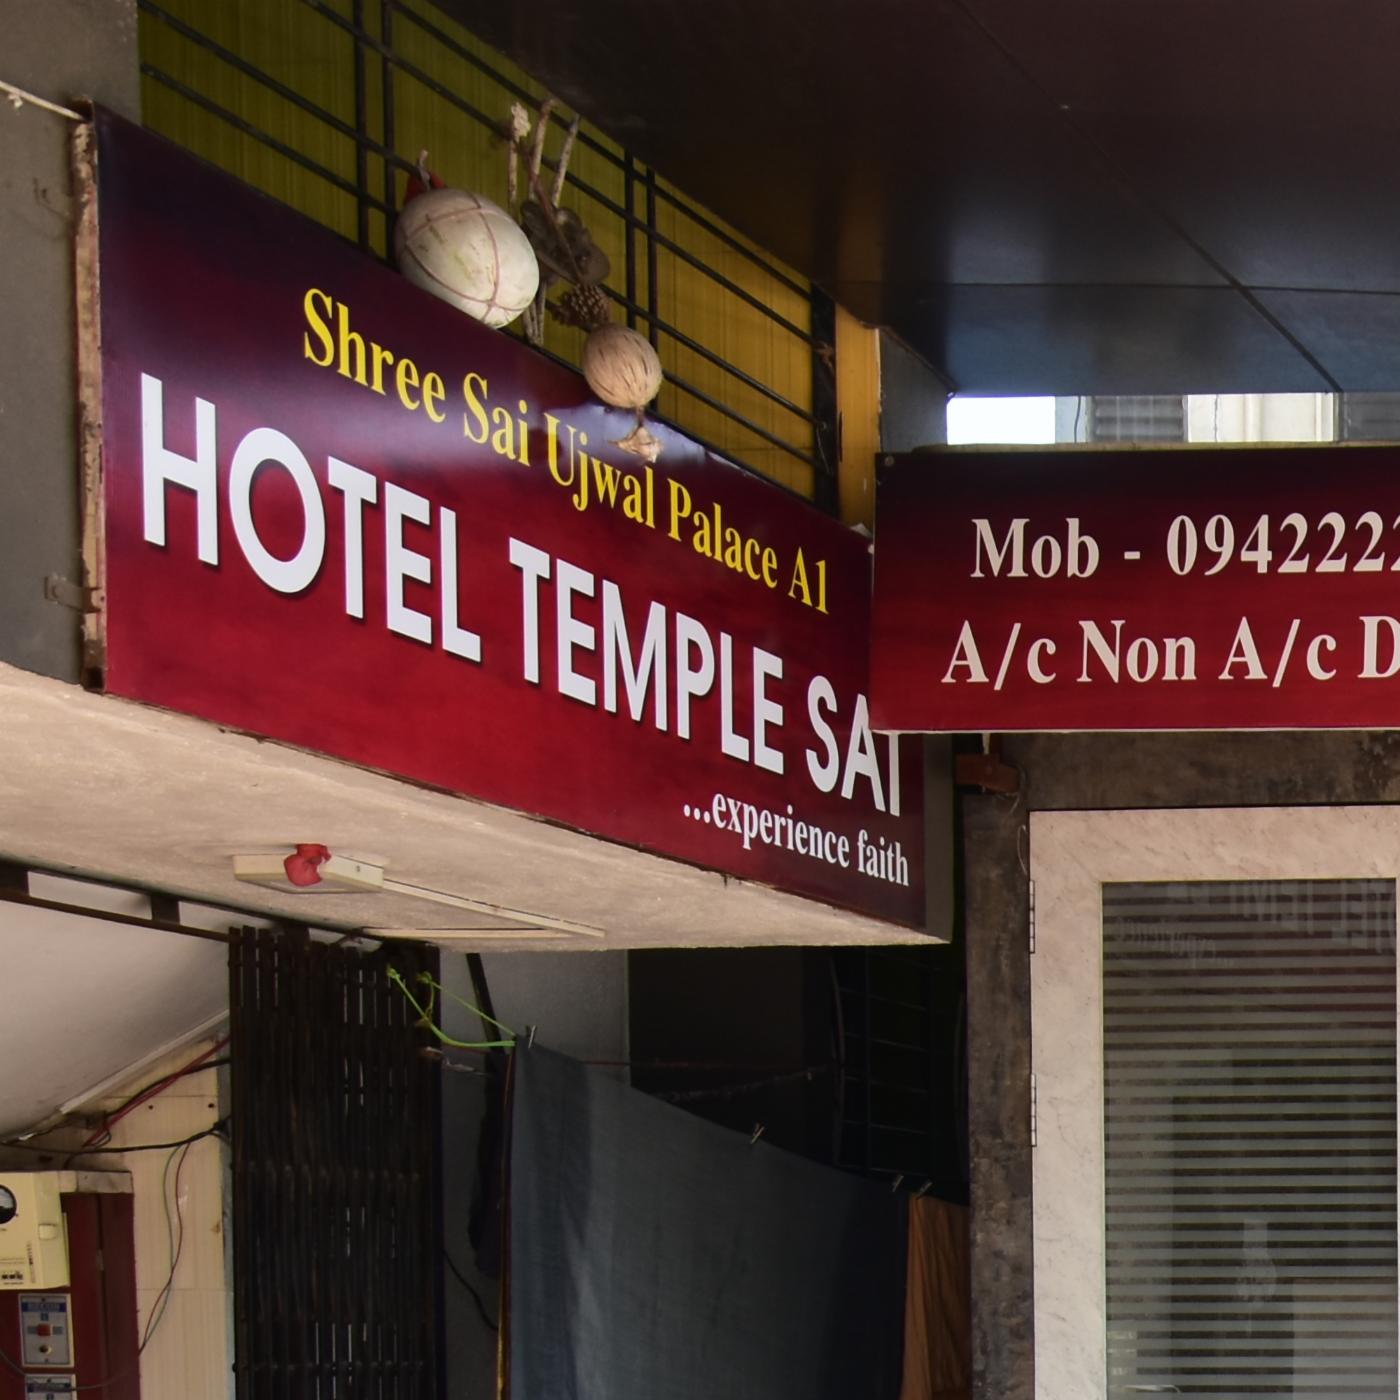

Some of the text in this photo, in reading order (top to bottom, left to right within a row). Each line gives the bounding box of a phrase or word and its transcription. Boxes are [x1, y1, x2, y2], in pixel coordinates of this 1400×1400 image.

[304, 288, 446, 423] Shree
[463, 372, 530, 467] Sai
[543, 412, 656, 529] Ujwal
[667, 477, 778, 589] Palace
[141, 372, 901, 817] HOTEL TEMPLE SAI
[970, 516, 1101, 579] Mob
[940, 619, 1057, 692] A/c
[1076, 619, 1198, 684] Non
[1218, 615, 1338, 689] A/c
[683, 792, 910, 887] ...experience faith
